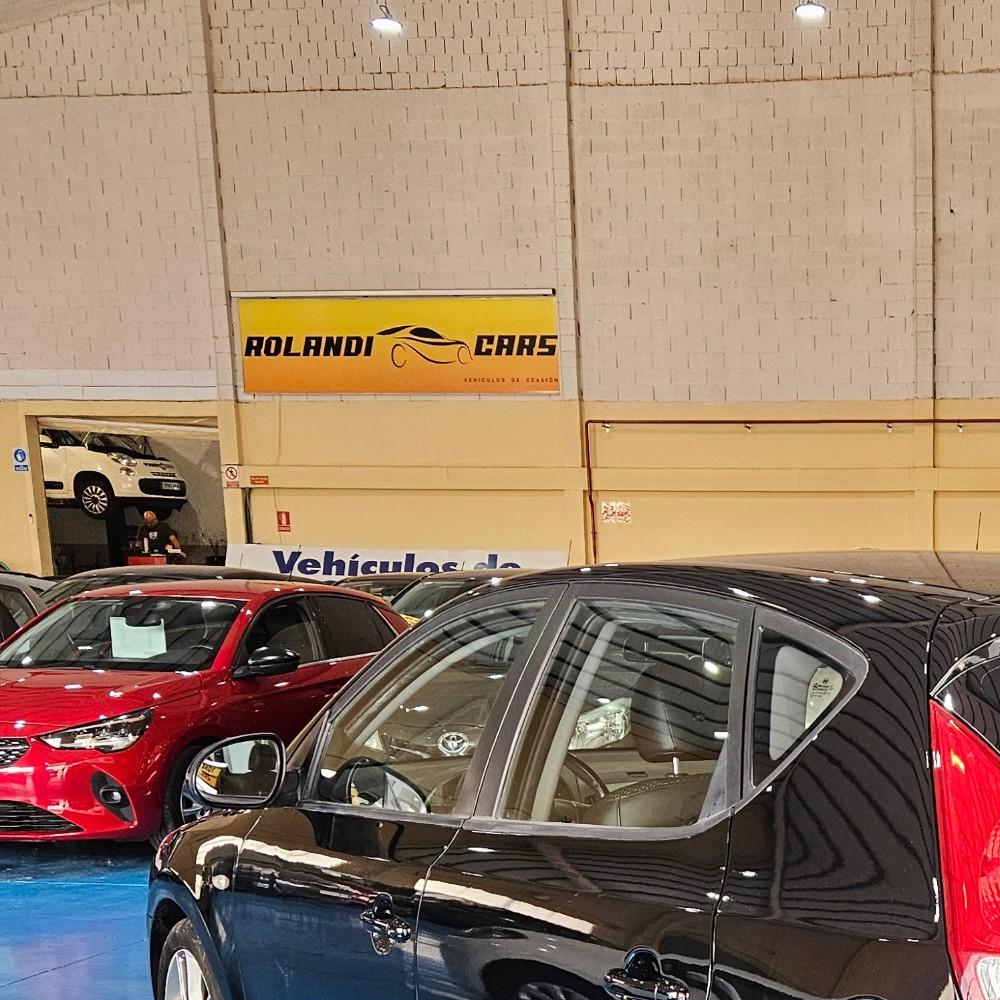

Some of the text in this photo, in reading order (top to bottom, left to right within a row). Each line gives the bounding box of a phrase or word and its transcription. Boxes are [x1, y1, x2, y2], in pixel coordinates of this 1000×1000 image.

[244, 334, 559, 357] ROLANDI CARS
[272, 550, 459, 577] Vehículos
